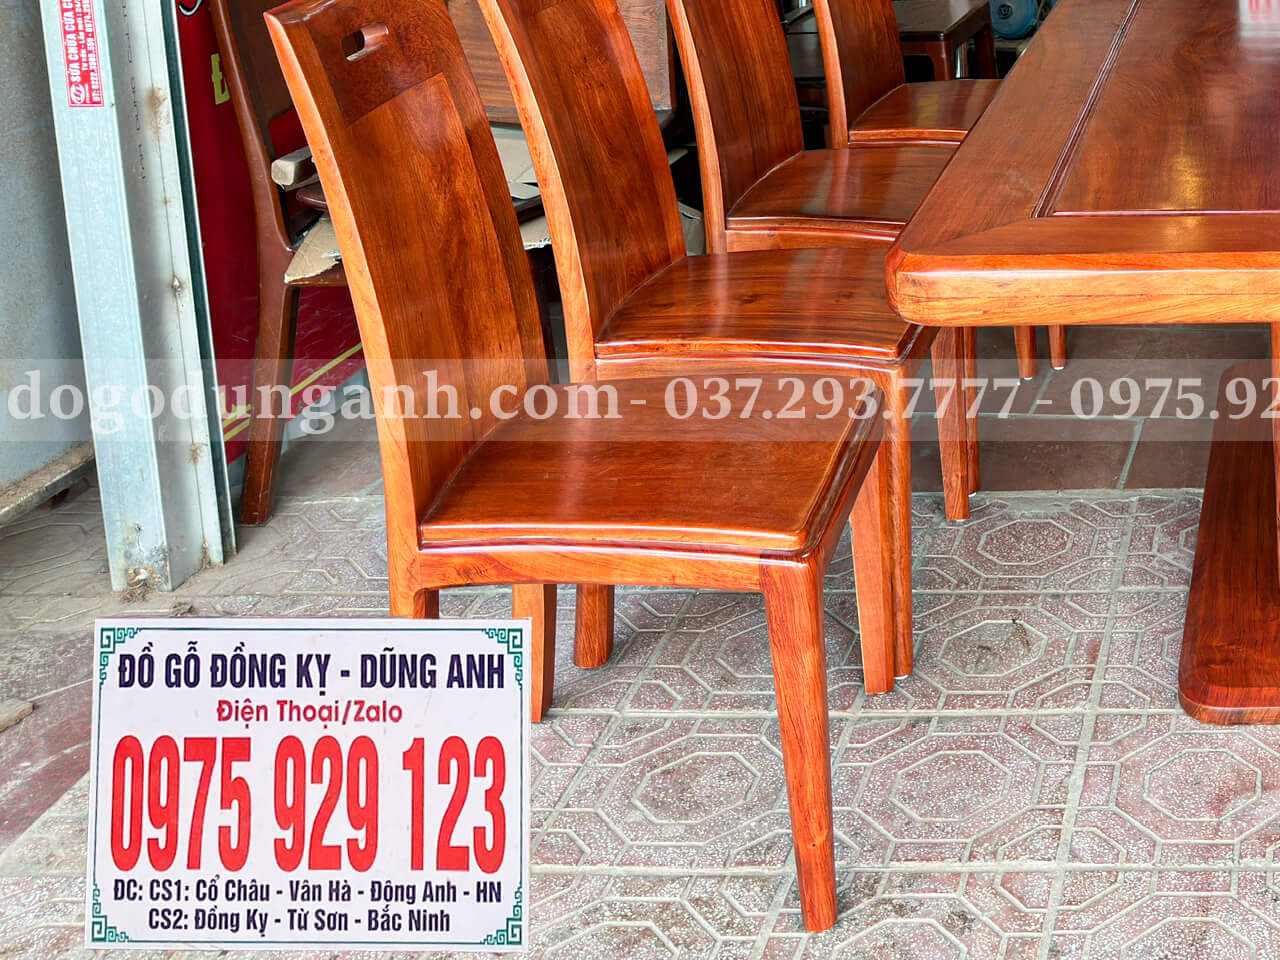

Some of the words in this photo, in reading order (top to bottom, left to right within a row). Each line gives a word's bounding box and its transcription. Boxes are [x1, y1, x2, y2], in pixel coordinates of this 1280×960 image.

[118, 641, 155, 689] ĐỒ
[164, 640, 200, 689] GỖ
[210, 641, 286, 689] ĐỒNG
[296, 653, 331, 697] KỴ
[360, 647, 437, 689] DŨNG
[446, 653, 505, 689] ANH
[217, 698, 268, 729] Điện
[276, 699, 403, 730] Thoại/Zalo
[111, 735, 252, 873] 0975
[273, 735, 380, 874] 929
[402, 735, 507, 874] 123
[113, 879, 144, 902] ĐC:
[149, 879, 189, 902] CS1:
[195, 874, 219, 902] Cổ
[225, 879, 270, 902] Châu
[289, 881, 322, 902] Vân
[328, 880, 352, 902] Hà
[370, 880, 417, 905] Đông
[422, 880, 457, 902] Anh
[476, 882, 502, 903] HN
[148, 908, 189, 930] CS2:
[194, 905, 240, 933] Đồng
[246, 908, 269, 937] Kỵ
[287, 906, 309, 931] Từ
[314, 909, 349, 932] Sơn
[367, 905, 402, 932] Bắc
[408, 909, 451, 932] Ninh
